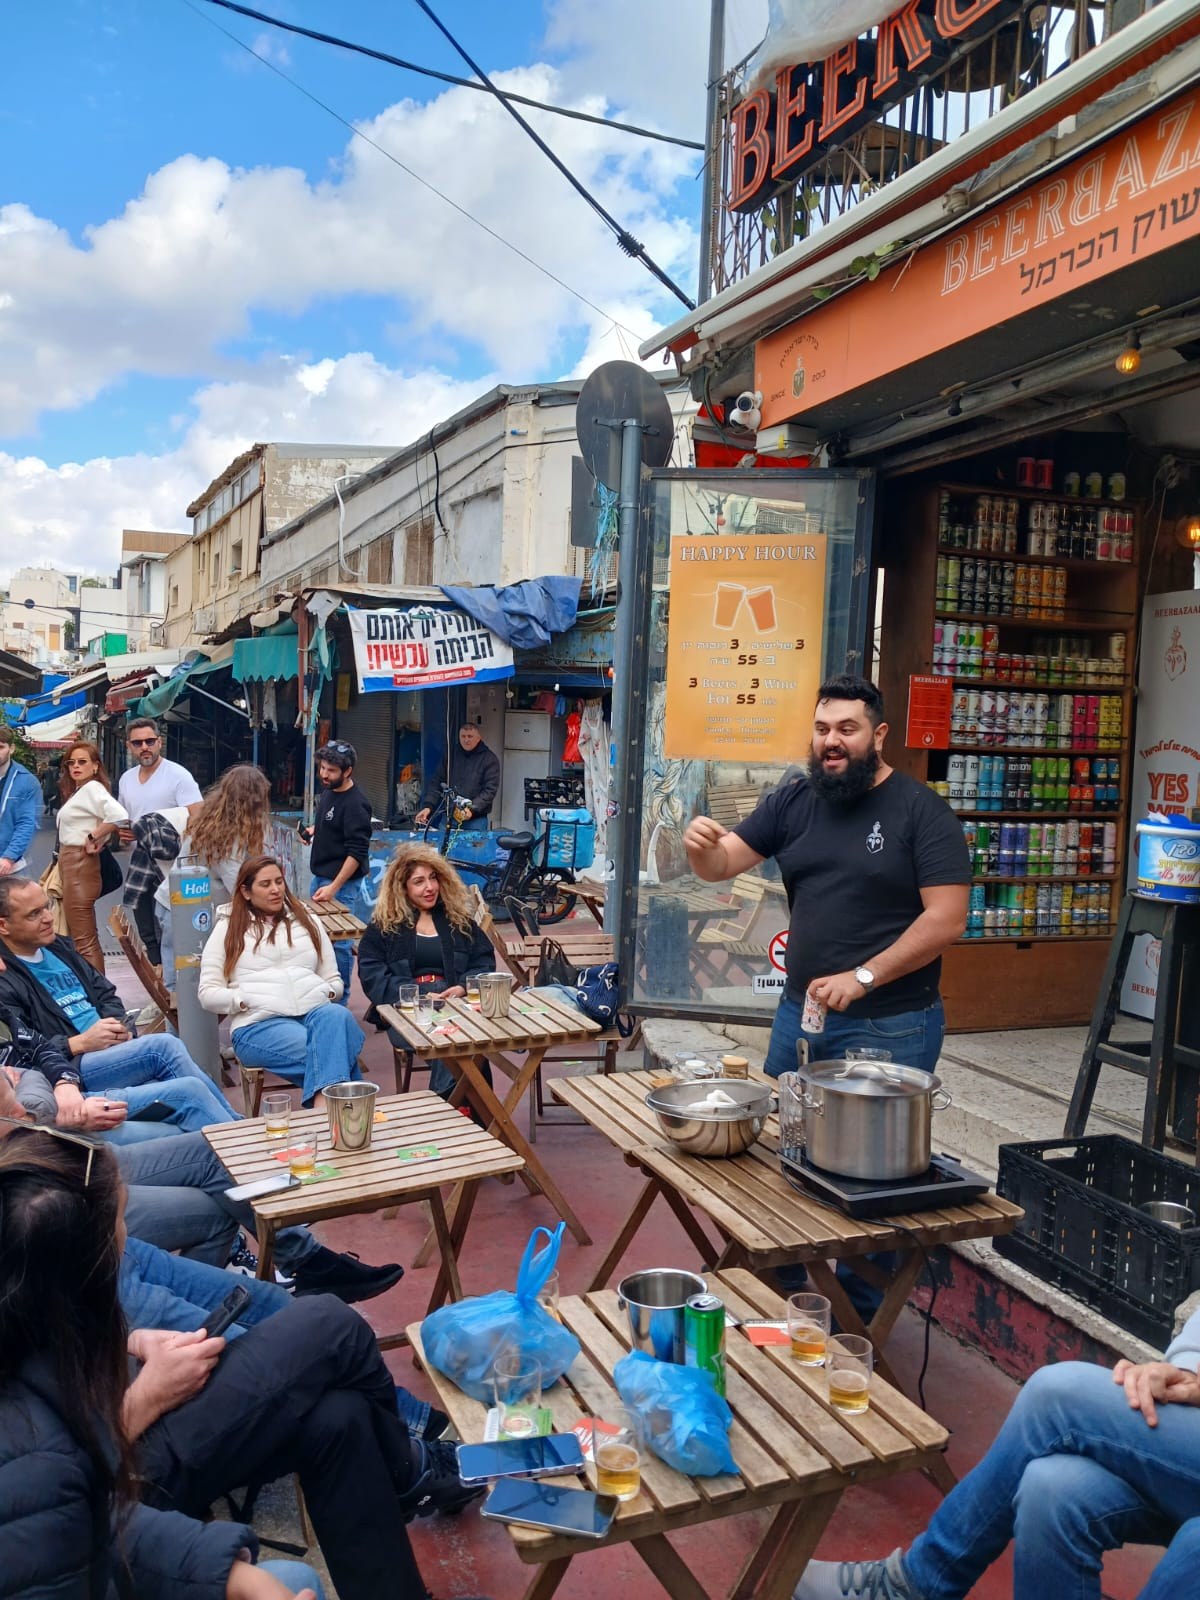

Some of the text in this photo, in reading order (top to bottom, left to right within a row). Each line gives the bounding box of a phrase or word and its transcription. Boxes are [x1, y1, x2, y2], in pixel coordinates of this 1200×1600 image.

[1019, 187, 1200, 296] שוק הכרמל
[680, 545, 817, 562] HAPPY HOUR
[366, 613, 416, 641] אותם
[366, 632, 494, 671] הביתה עכשיו!
[730, 639, 740, 650] 3
[795, 639, 805, 650] 3
[688, 677, 698, 688] 3
[750, 678, 760, 689] 3
[1147, 771, 1190, 803] YES
[560, 831, 574, 863] Wolt
[757, 978, 785, 989] עשן!
